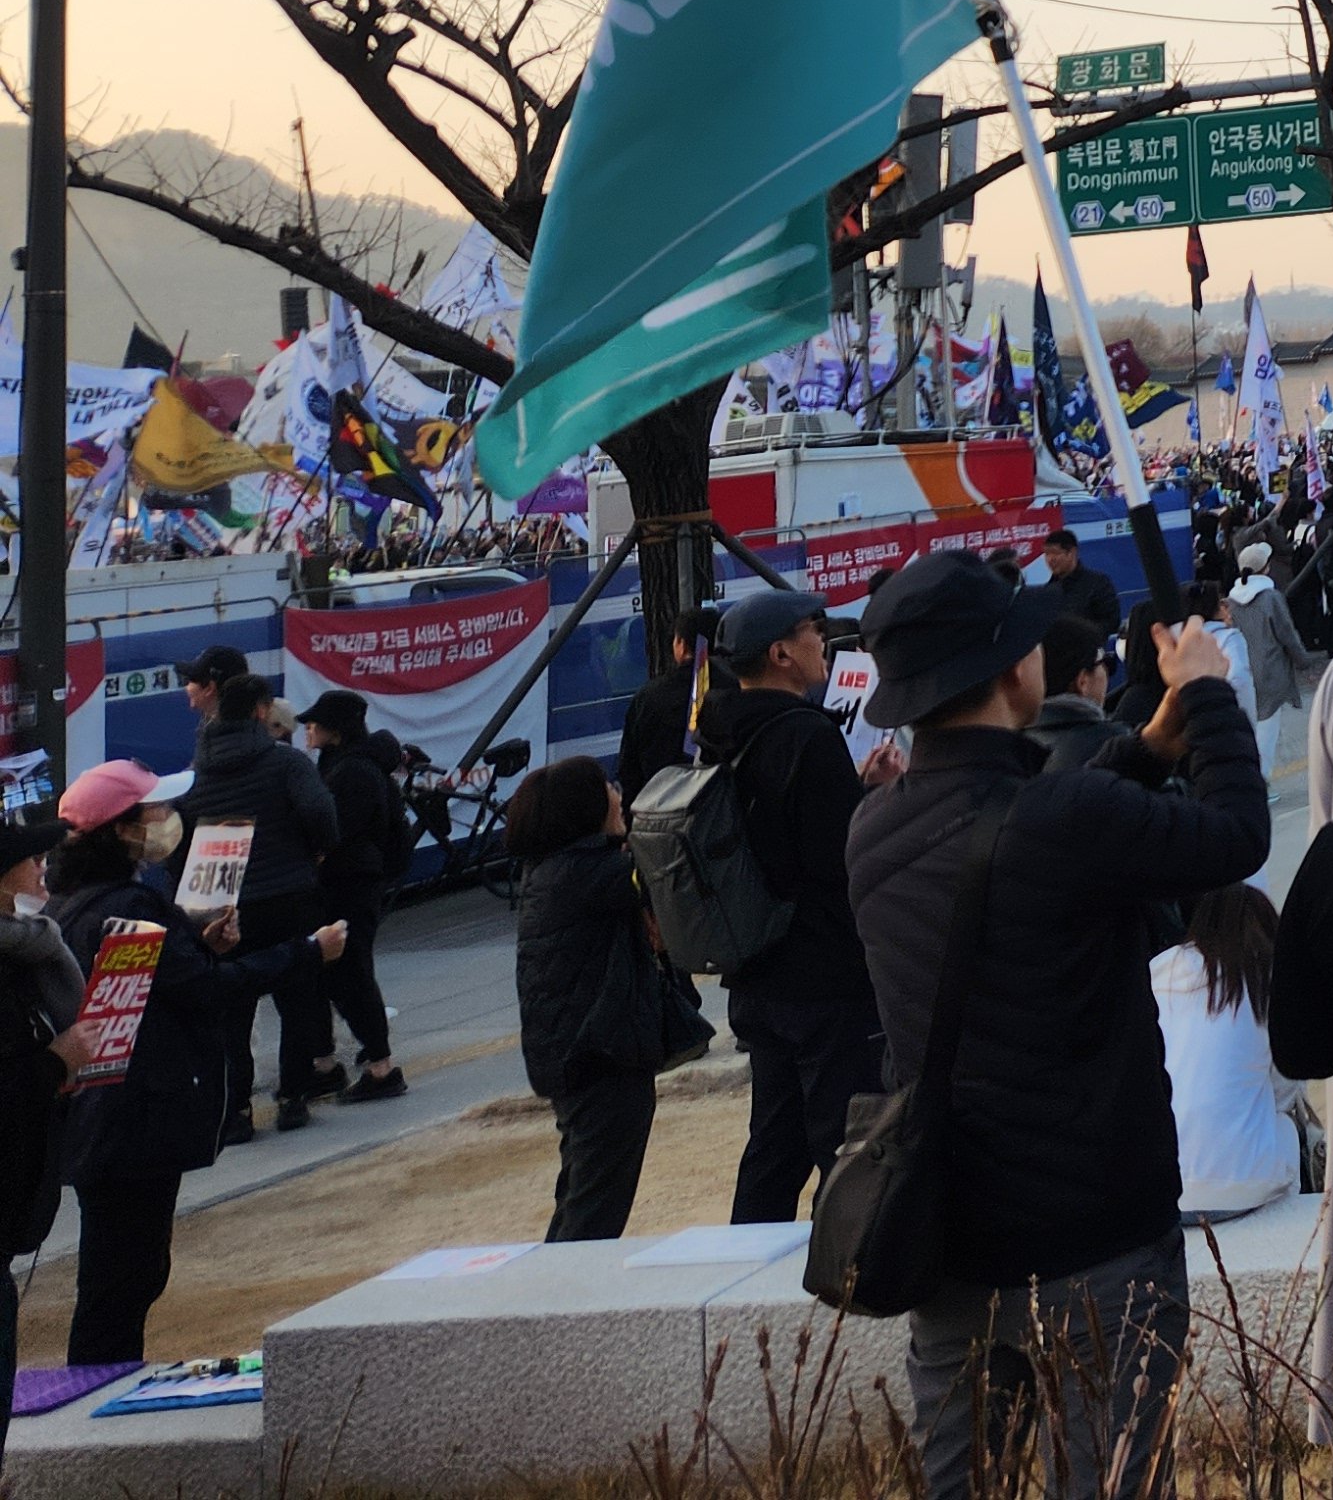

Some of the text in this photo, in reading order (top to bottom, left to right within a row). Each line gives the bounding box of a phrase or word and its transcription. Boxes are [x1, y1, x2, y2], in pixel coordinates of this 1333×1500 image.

[1071, 51, 1150, 86] 광화문
[1208, 117, 1321, 156] 안국동사거리
[1066, 137, 1123, 168] 독립문
[1210, 153, 1316, 179] Angukdong Jc
[1067, 165, 1179, 192] Dongnimmun
[1079, 201, 1158, 223] 21 50
[1252, 190, 1271, 206] 50
[381, 628, 410, 649] 긴급
[413, 621, 456, 645] 서비스
[399, 650, 441, 673] 유의해
[445, 636, 493, 664] 주세요!
